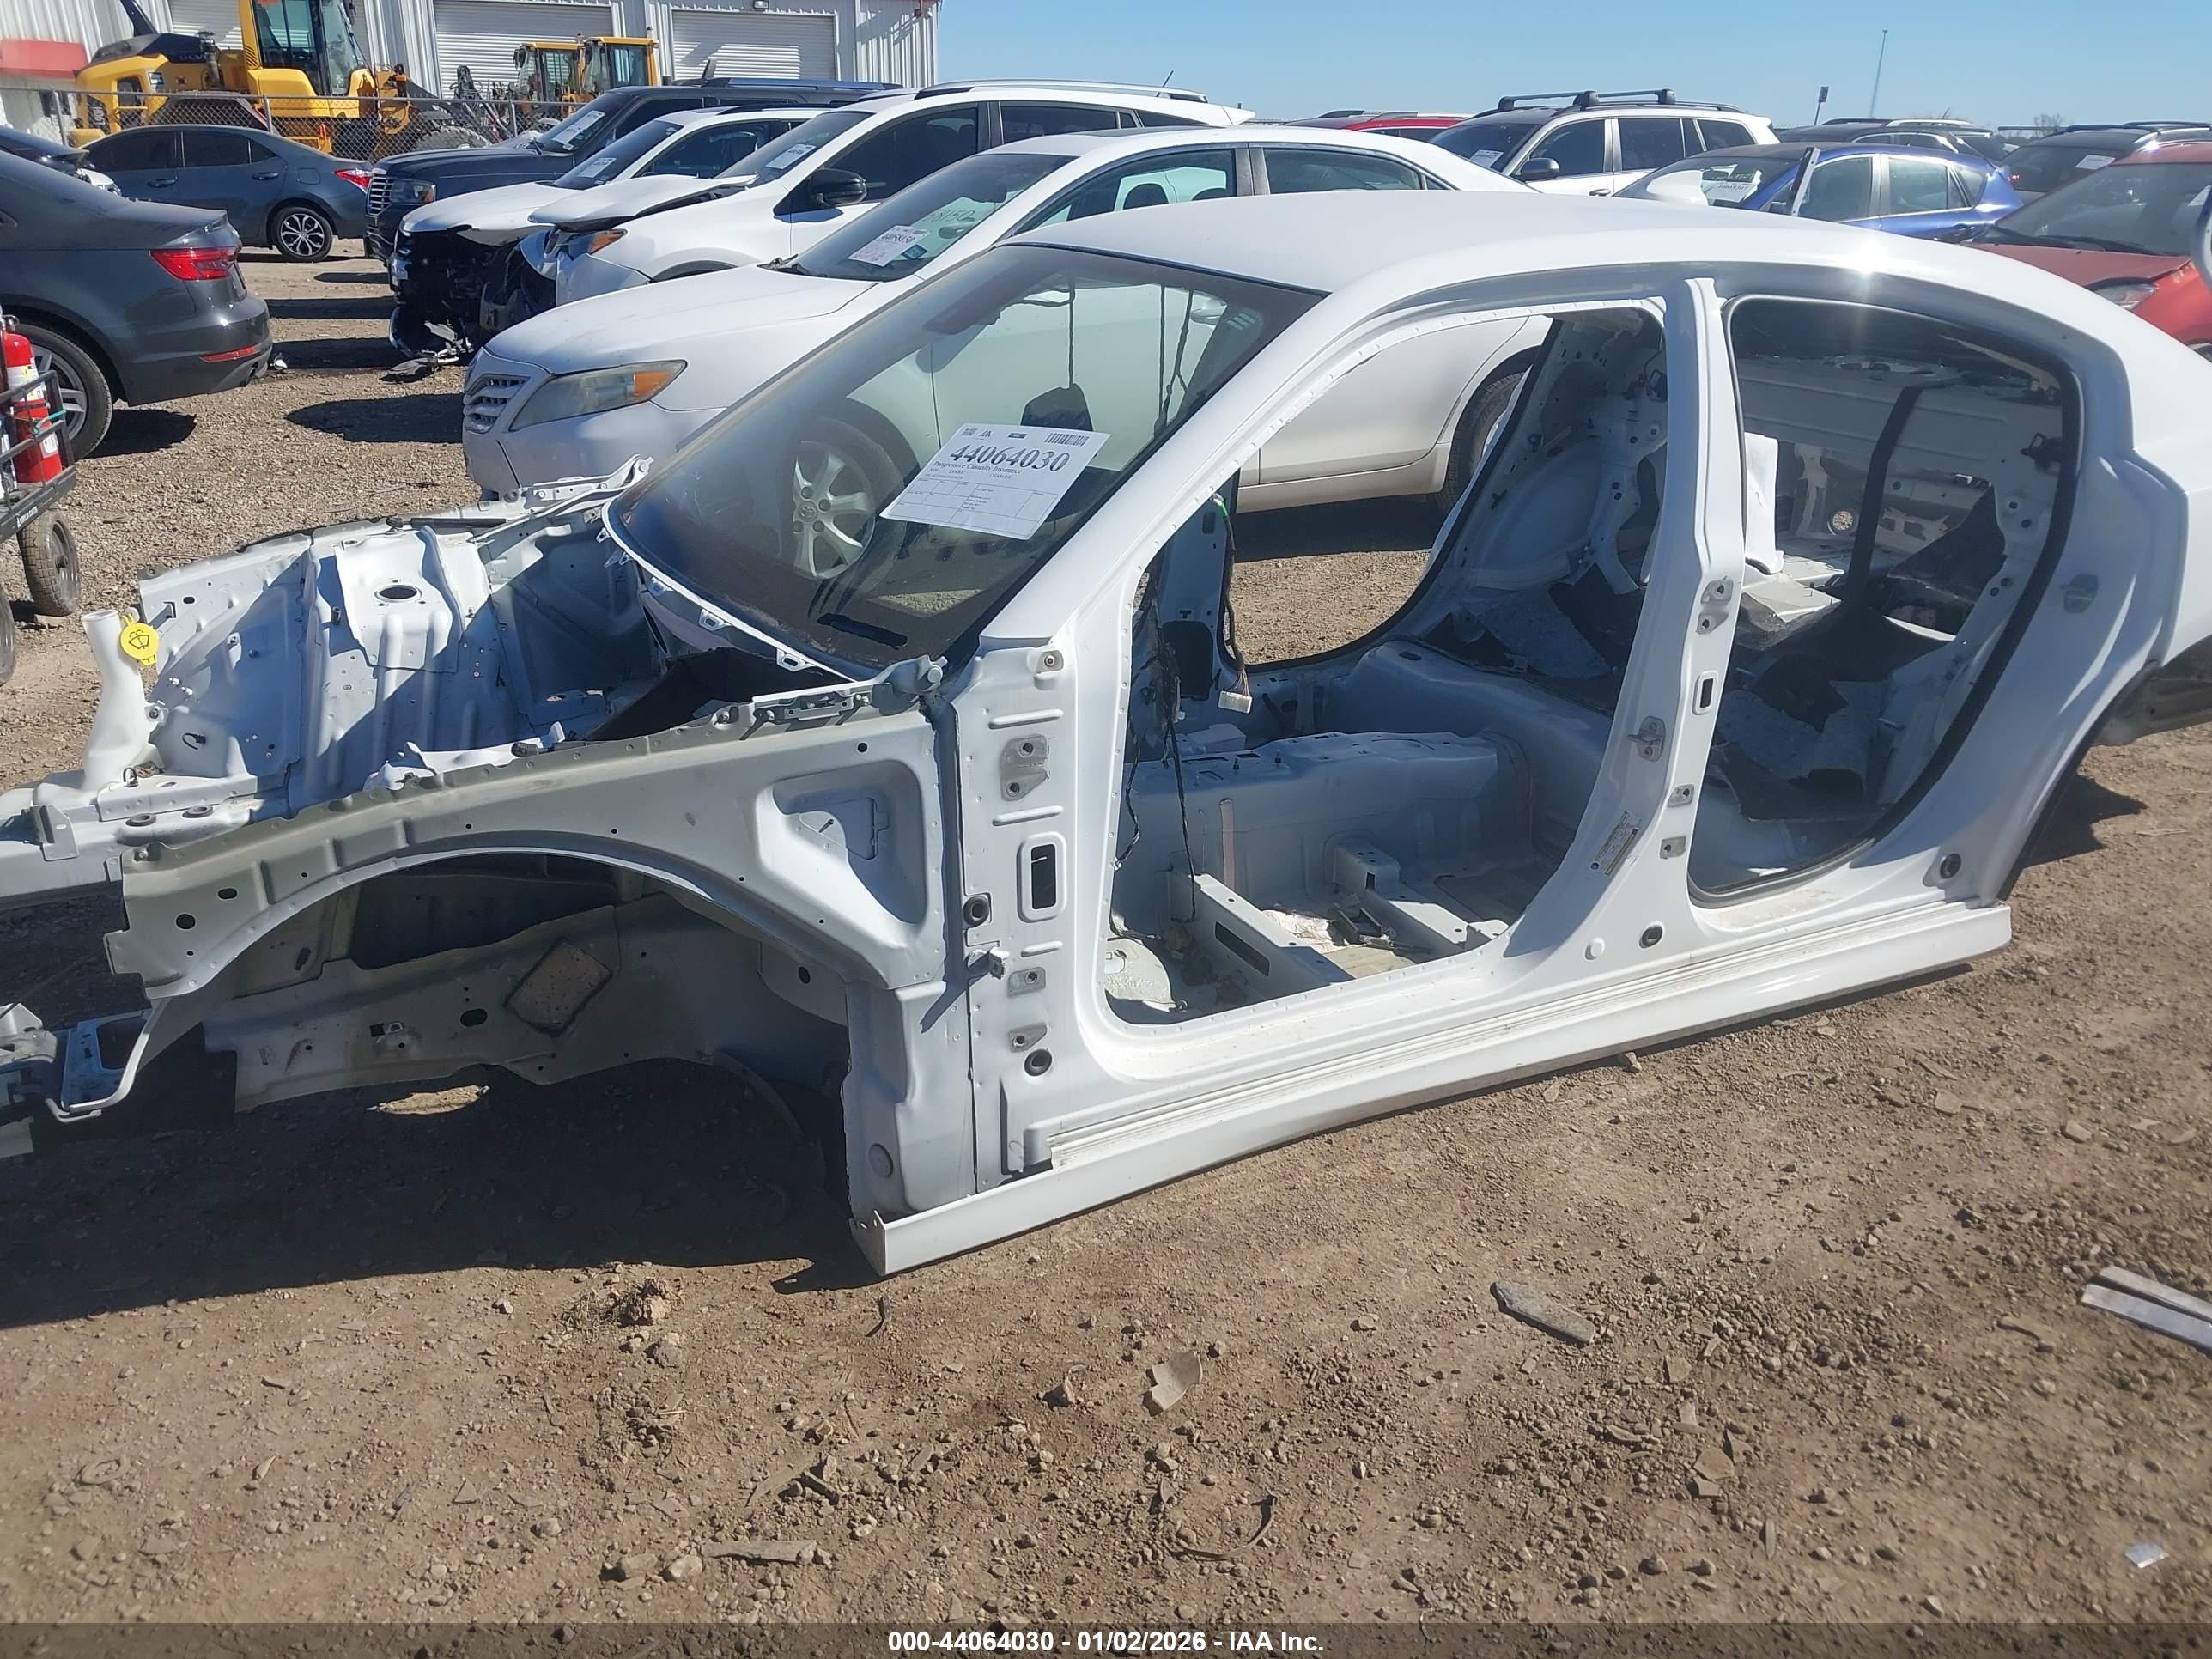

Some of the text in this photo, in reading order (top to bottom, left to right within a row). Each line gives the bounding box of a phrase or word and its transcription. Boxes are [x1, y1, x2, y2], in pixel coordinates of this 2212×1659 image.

[950, 444, 1070, 471] 44064030
[967, 464, 991, 472] Casualty
[993, 465, 1023, 474] Insurance
